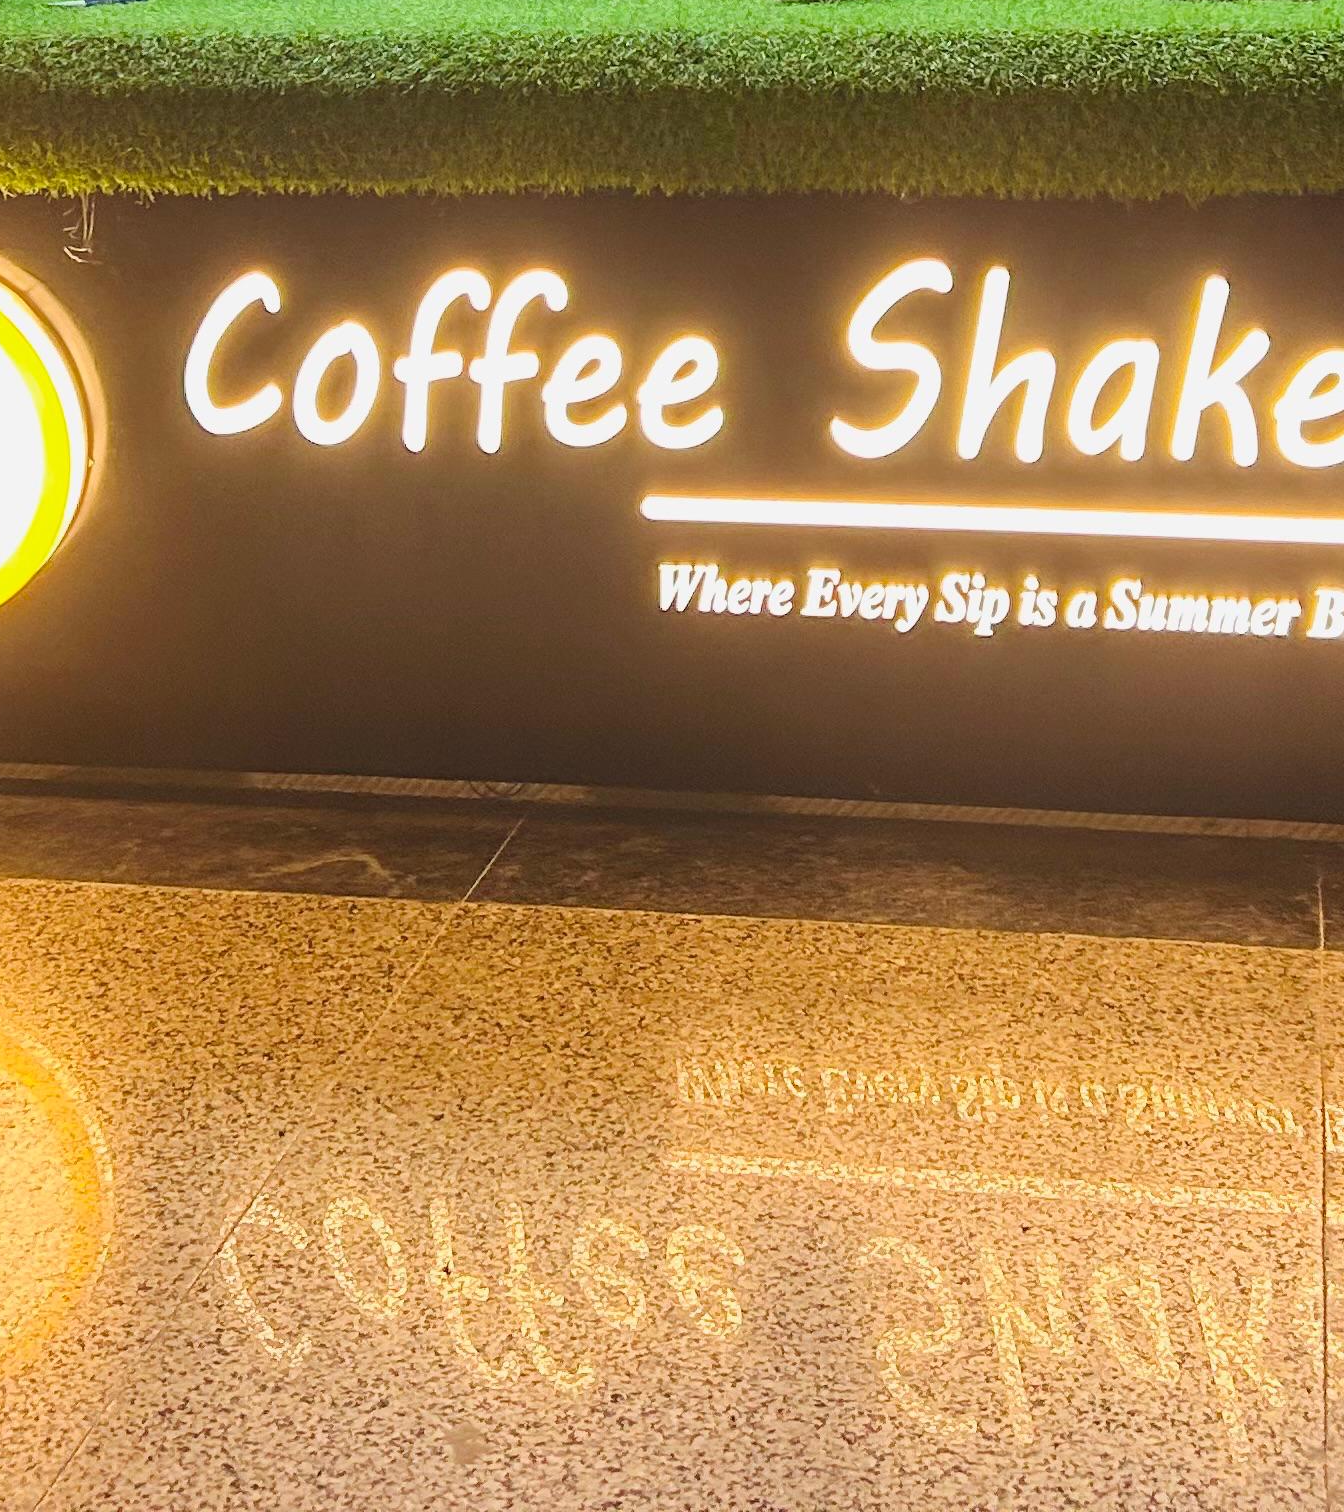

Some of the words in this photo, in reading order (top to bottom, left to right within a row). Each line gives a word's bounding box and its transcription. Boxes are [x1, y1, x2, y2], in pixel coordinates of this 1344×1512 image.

[184, 269, 725, 453] Coffee
[657, 563, 794, 617] Where
[802, 568, 930, 633] Every
[935, 572, 1010, 637] Sip
[1018, 576, 1059, 626] is
[1066, 590, 1098, 628] a
[1104, 578, 1302, 637] Summer
